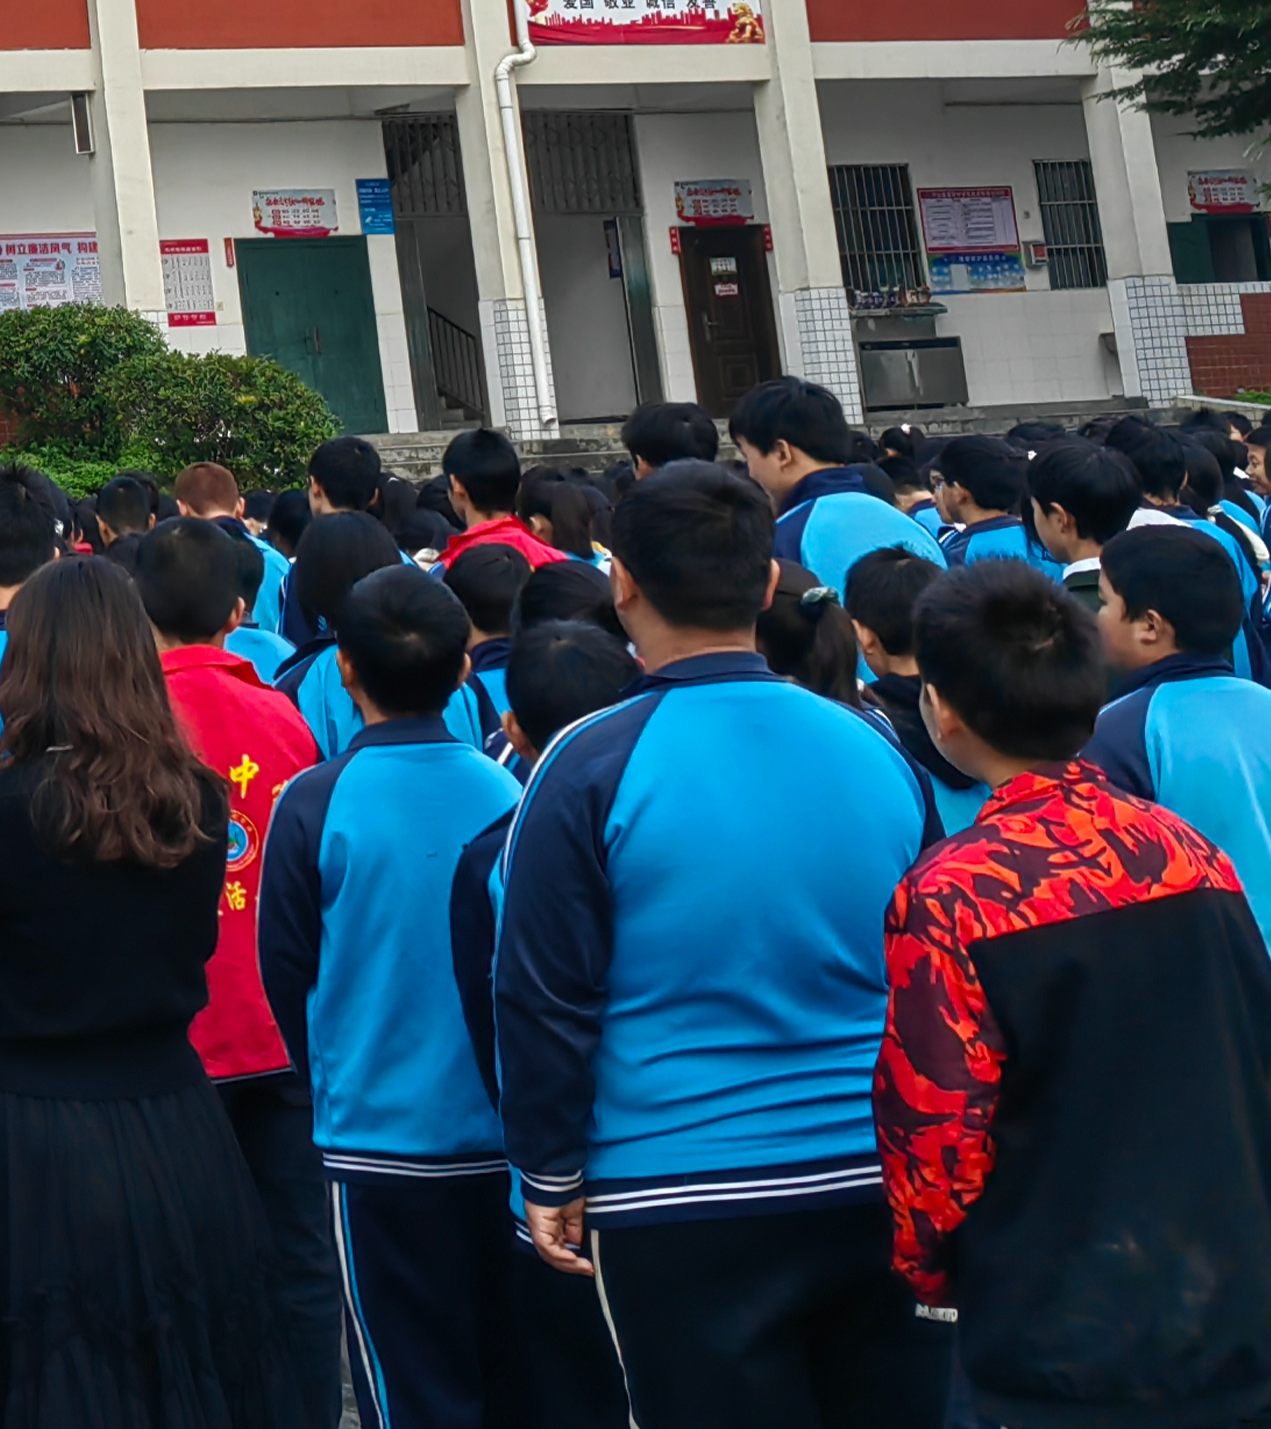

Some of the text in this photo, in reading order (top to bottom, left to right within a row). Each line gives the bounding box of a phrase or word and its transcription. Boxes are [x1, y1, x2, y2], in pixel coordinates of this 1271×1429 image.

[5, 241, 72, 255] 树立廉洁风气
